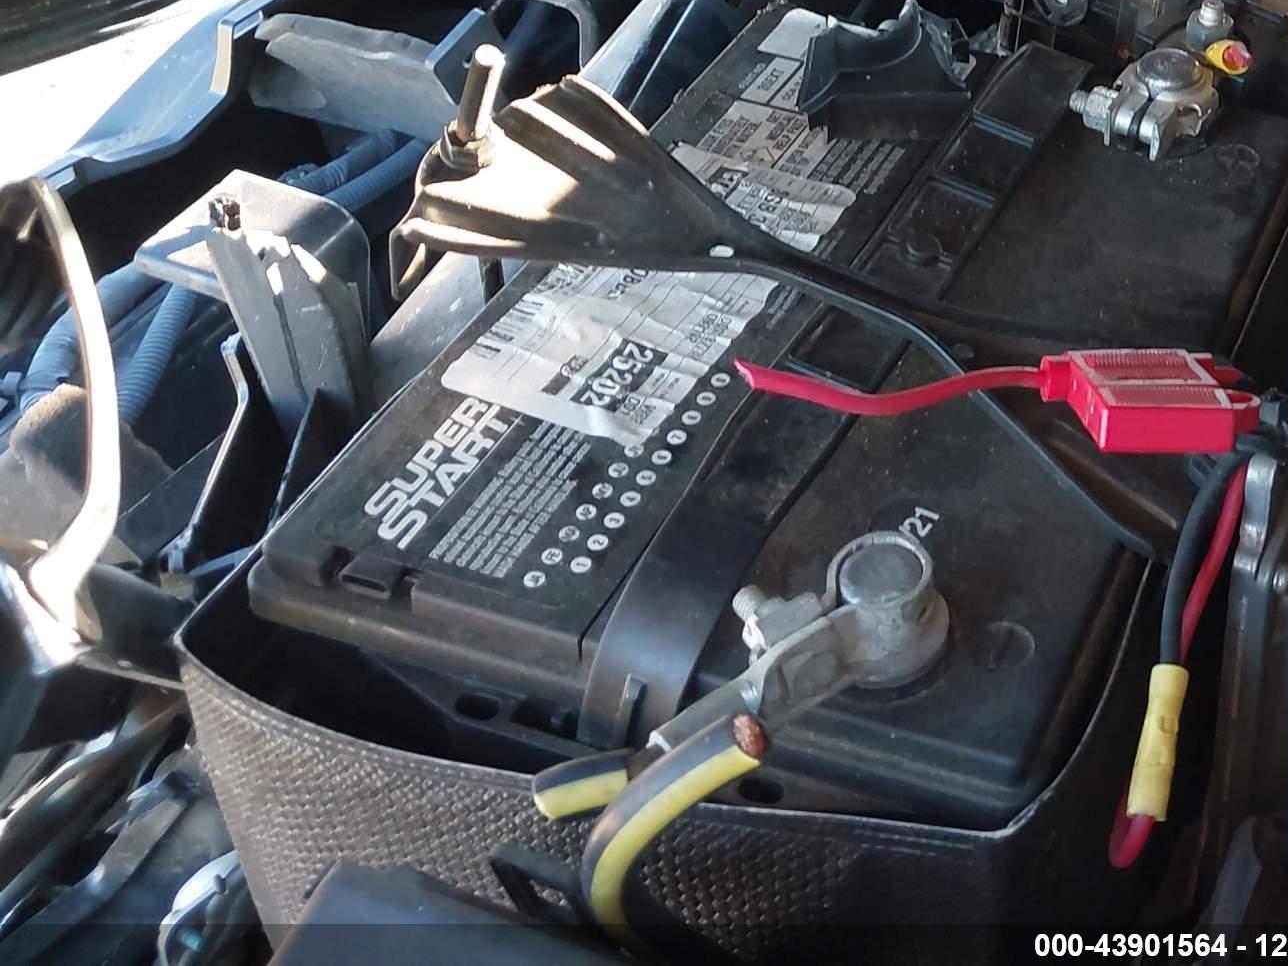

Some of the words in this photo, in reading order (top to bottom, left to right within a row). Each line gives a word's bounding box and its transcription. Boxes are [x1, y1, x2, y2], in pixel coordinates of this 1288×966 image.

[580, 341, 654, 408] 25202
[364, 397, 489, 521] SUPER
[377, 403, 510, 550] START
